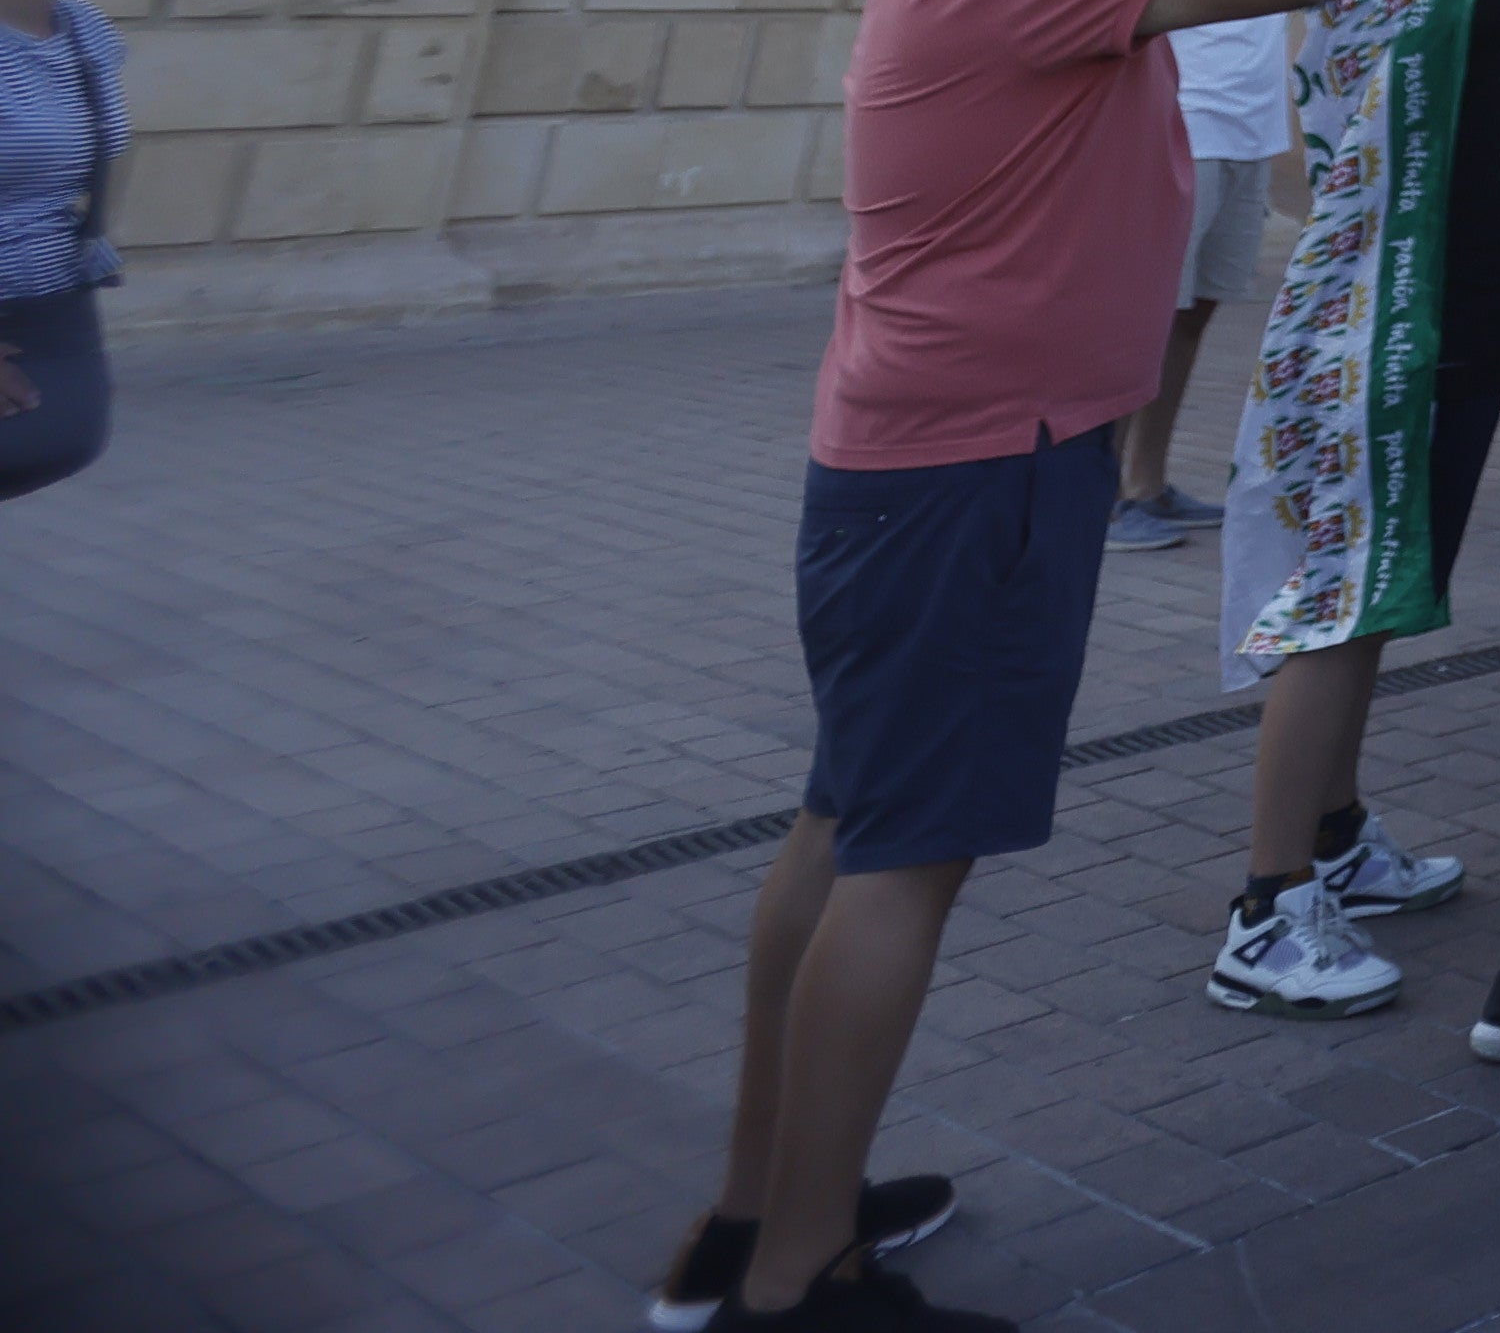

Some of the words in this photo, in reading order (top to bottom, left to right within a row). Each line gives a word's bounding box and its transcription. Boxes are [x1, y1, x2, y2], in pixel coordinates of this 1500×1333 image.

[1397, 52, 1430, 126] pasión
[1387, 236, 1417, 314] pasión
[1375, 428, 1408, 508] pasión
